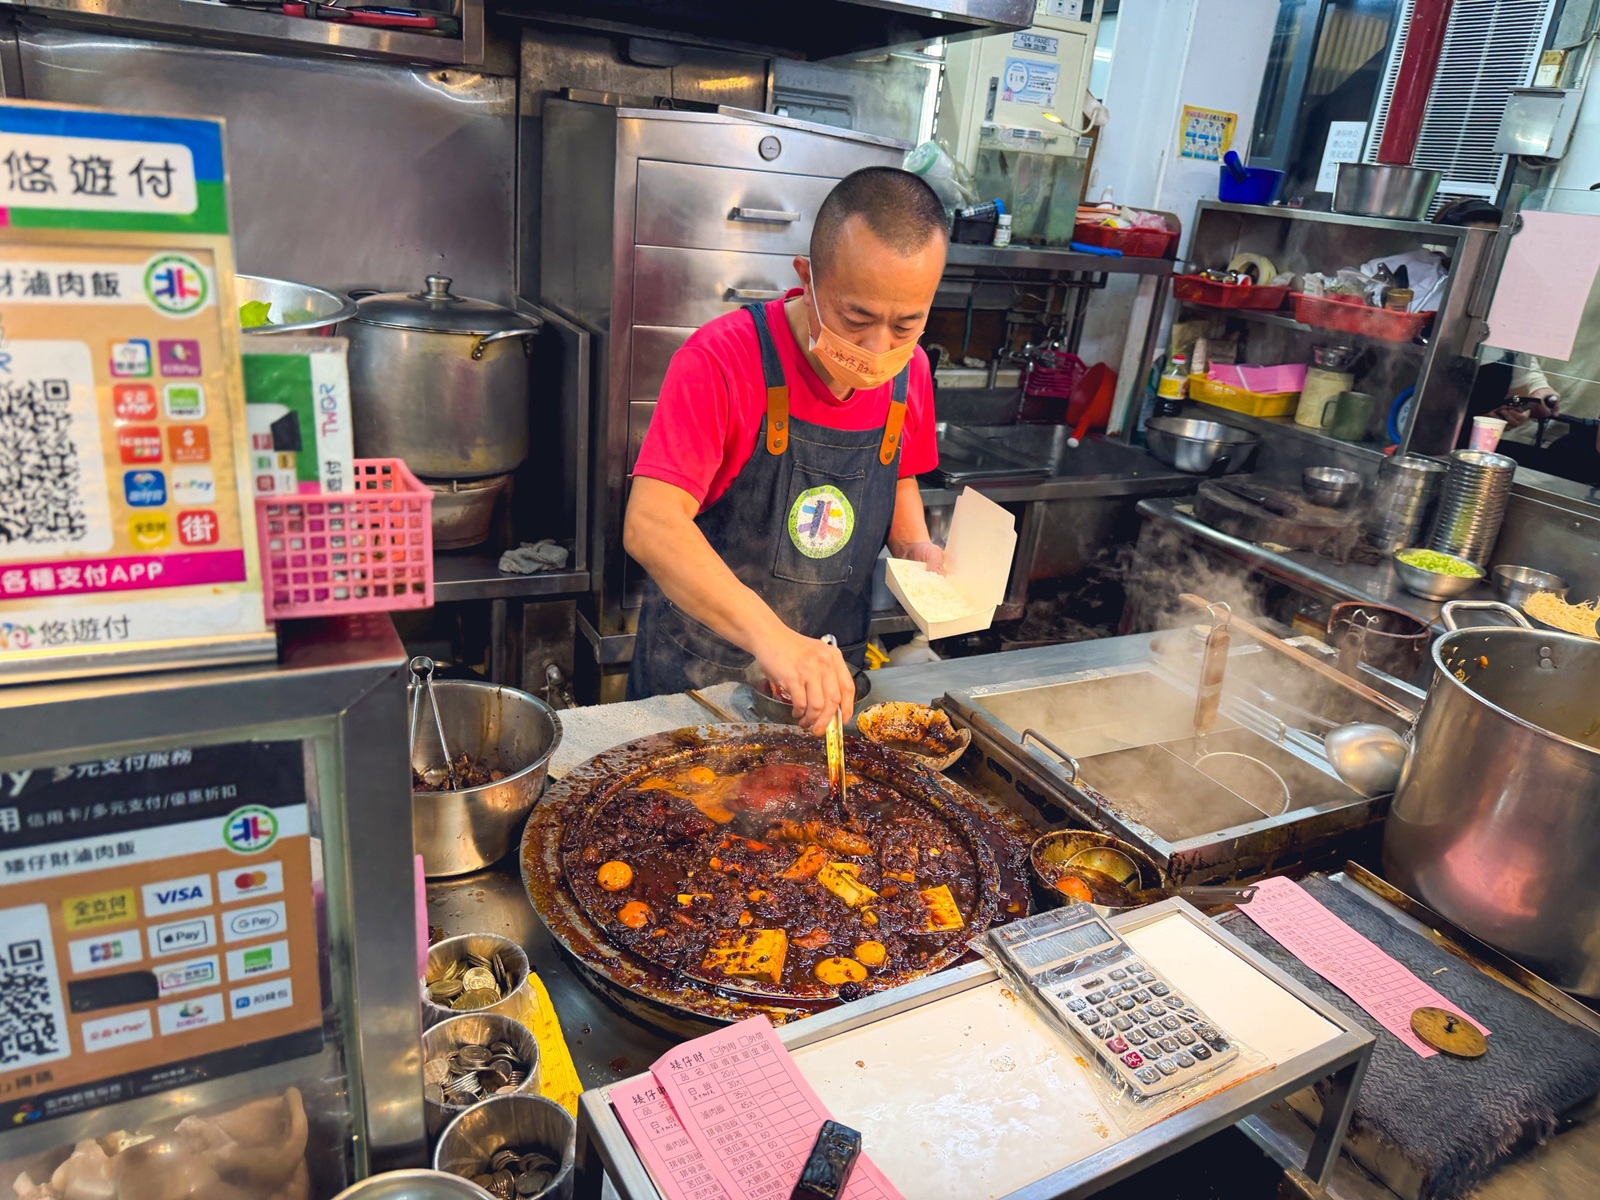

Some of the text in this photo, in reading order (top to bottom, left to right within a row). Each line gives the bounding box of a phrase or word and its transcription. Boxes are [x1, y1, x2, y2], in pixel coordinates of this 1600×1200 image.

[4, 150, 177, 199] 悠遊付
[181, 513, 215, 542] 街
[2, 561, 163, 592] 各種支付APP
[40, 614, 131, 645] 悠遊付
[0, 749, 193, 797] y 多元支付服務
[5, 840, 135, 874] 矮仔財滷肉飯
[153, 885, 203, 905] VISA
[251, 916, 271, 928] Pay
[175, 928, 201, 943] Pay
[1151, 1002, 1161, 1013] 9
[1134, 1010, 1145, 1020] 8
[1166, 1017, 1175, 1026] 6
[1149, 1025, 1158, 1034] 5
[1132, 1031, 1142, 1041] 4
[1181, 1031, 1191, 1041] 3
[1113, 1039, 1124, 1048] C
[1163, 1039, 1174, 1048] 2
[670, 1051, 705, 1071] 矮仔財
[1126, 1054, 1140, 1063] AC
[1160, 1061, 1174, 1071] 00
[1145, 1070, 1154, 1079] 0
[753, 1122, 763, 1130] 70
[781, 1160, 794, 1170] 120
